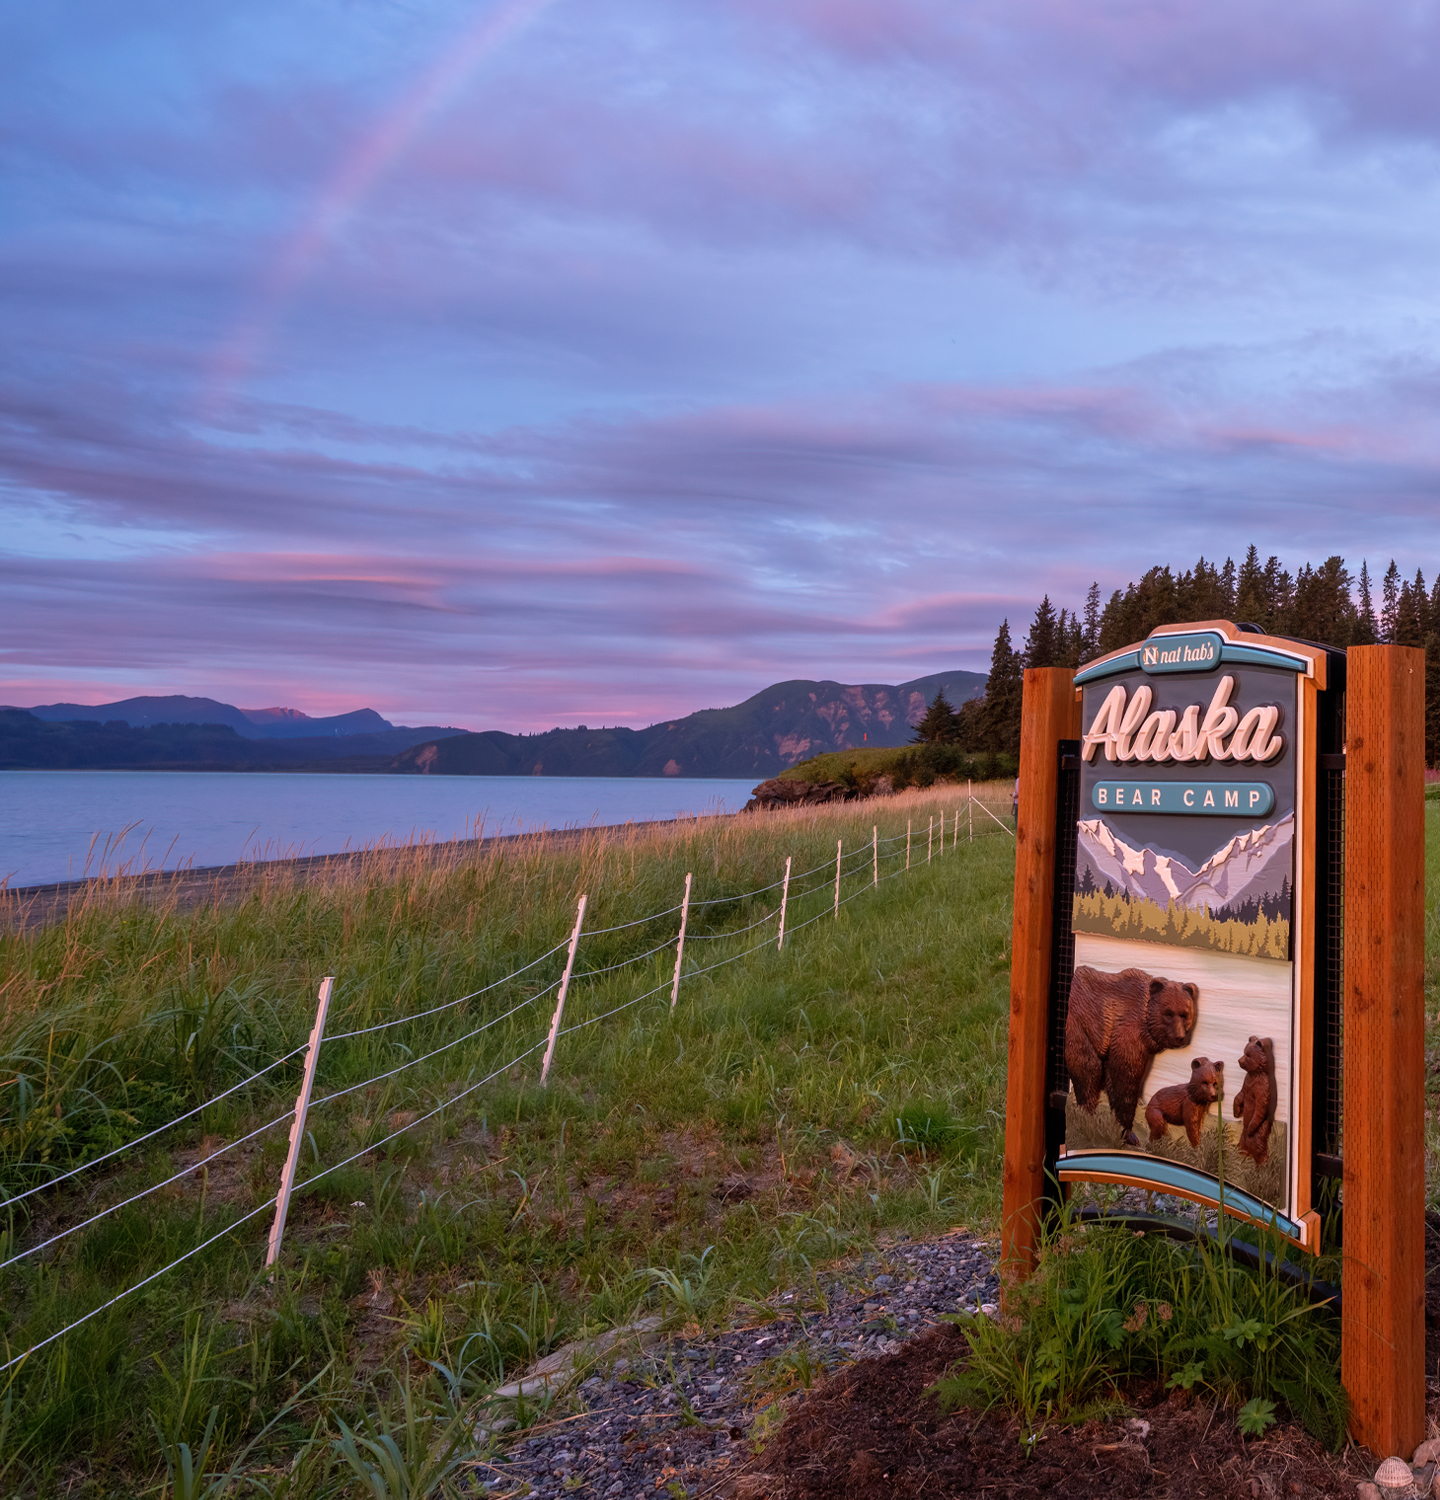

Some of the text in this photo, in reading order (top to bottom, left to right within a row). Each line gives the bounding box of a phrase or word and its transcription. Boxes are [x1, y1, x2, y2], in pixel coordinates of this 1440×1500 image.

[1160, 646, 1182, 664] nat
[1183, 641, 1214, 662] hab's
[1082, 675, 1283, 762] Alaska
[1098, 788, 1261, 808] BEAR CAMP
